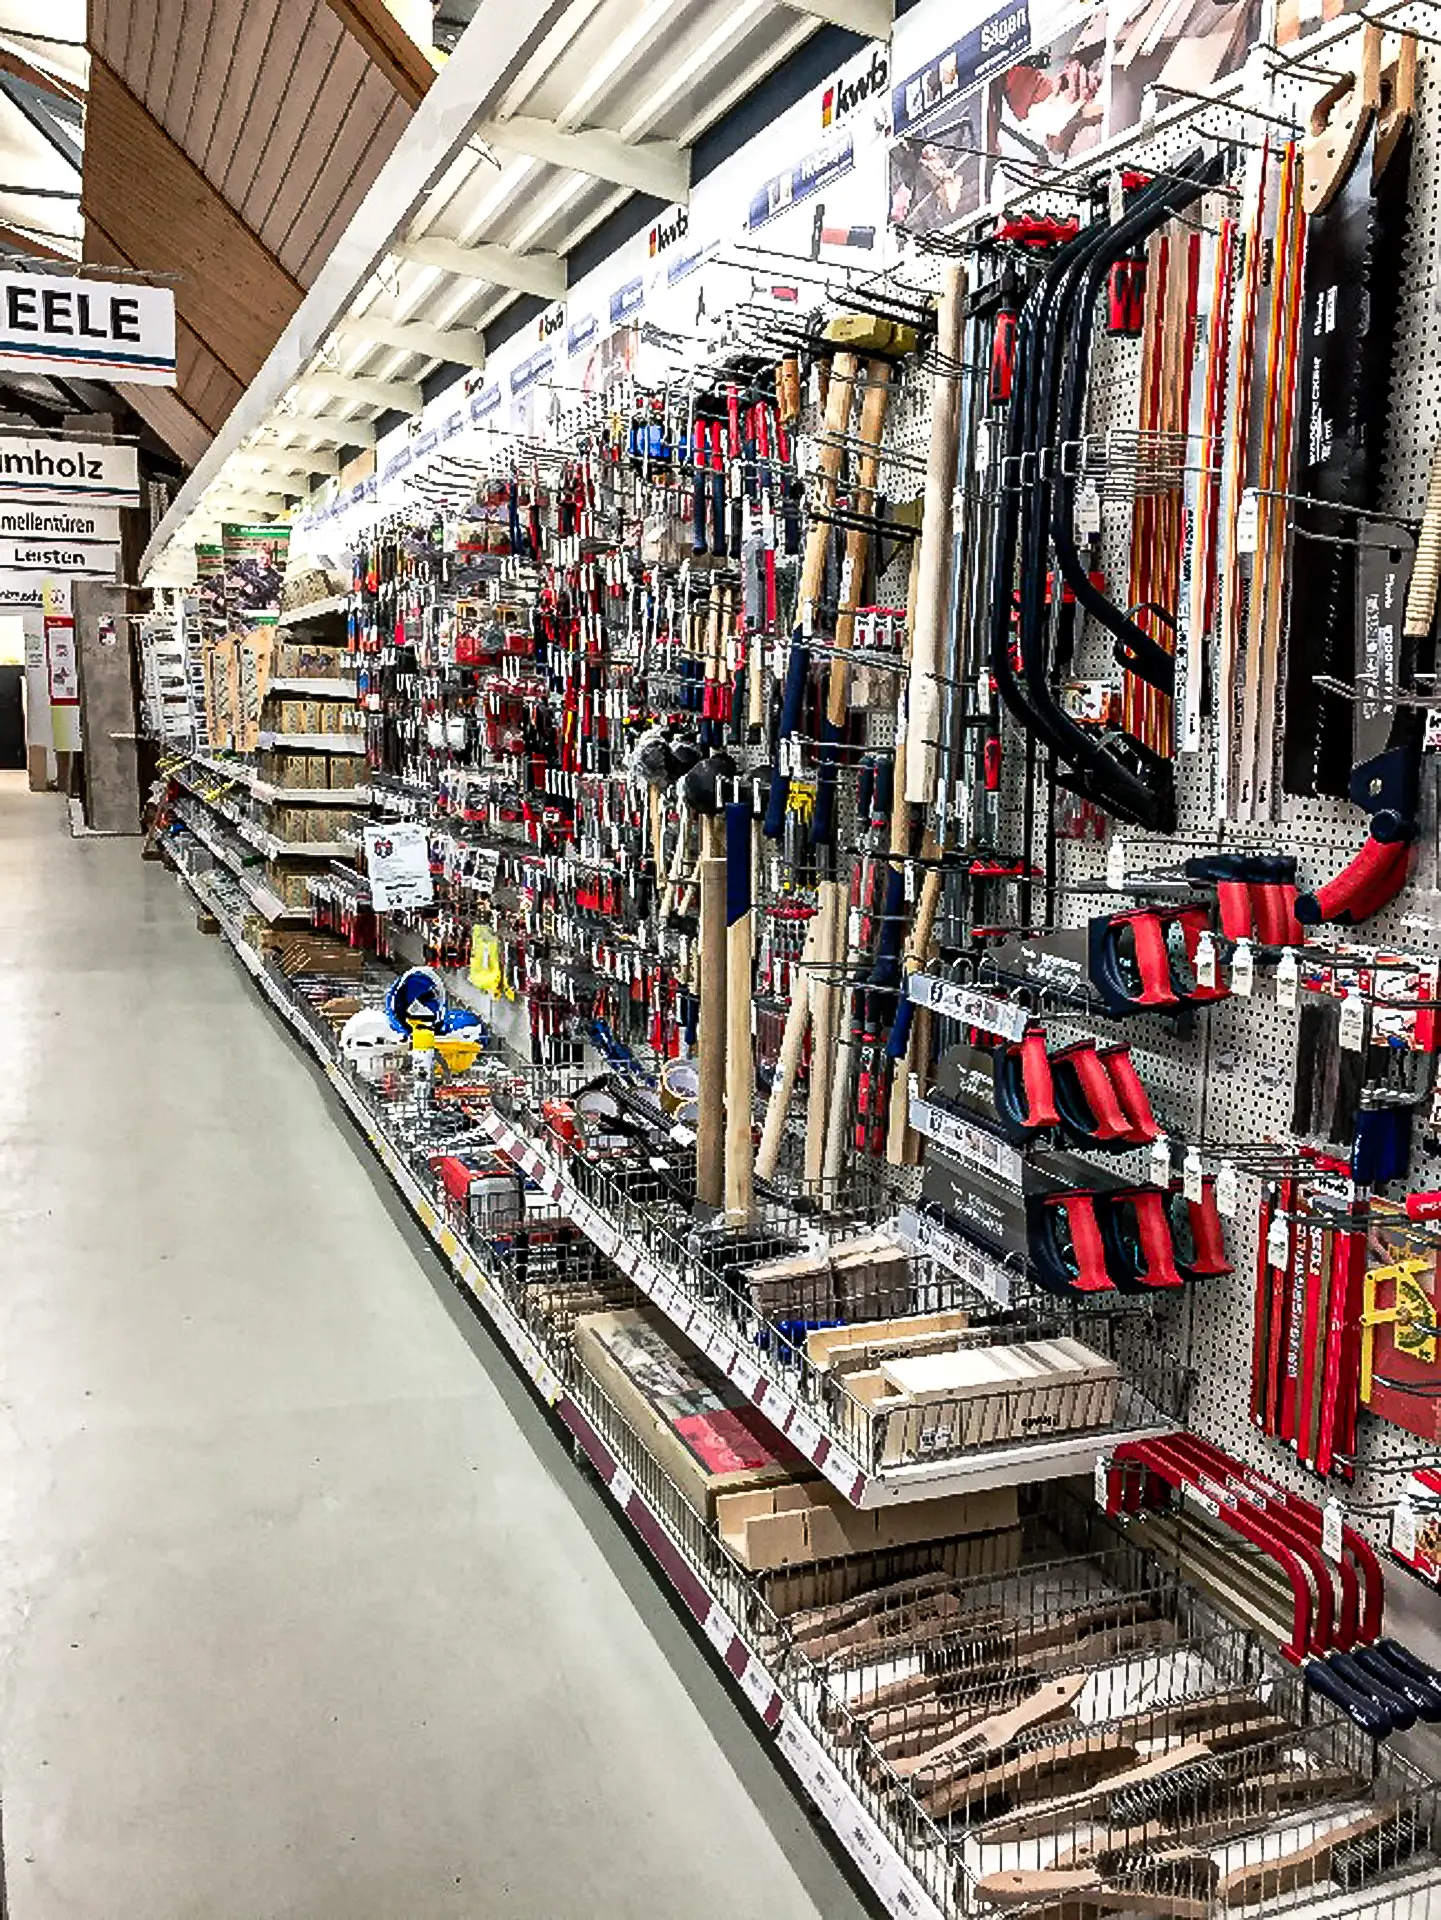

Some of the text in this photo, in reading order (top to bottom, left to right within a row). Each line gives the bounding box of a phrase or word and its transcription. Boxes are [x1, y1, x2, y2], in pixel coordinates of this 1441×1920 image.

[836, 50, 888, 120] kwb
[6, 286, 140, 342] EELE
[15, 549, 85, 565] Leisten
